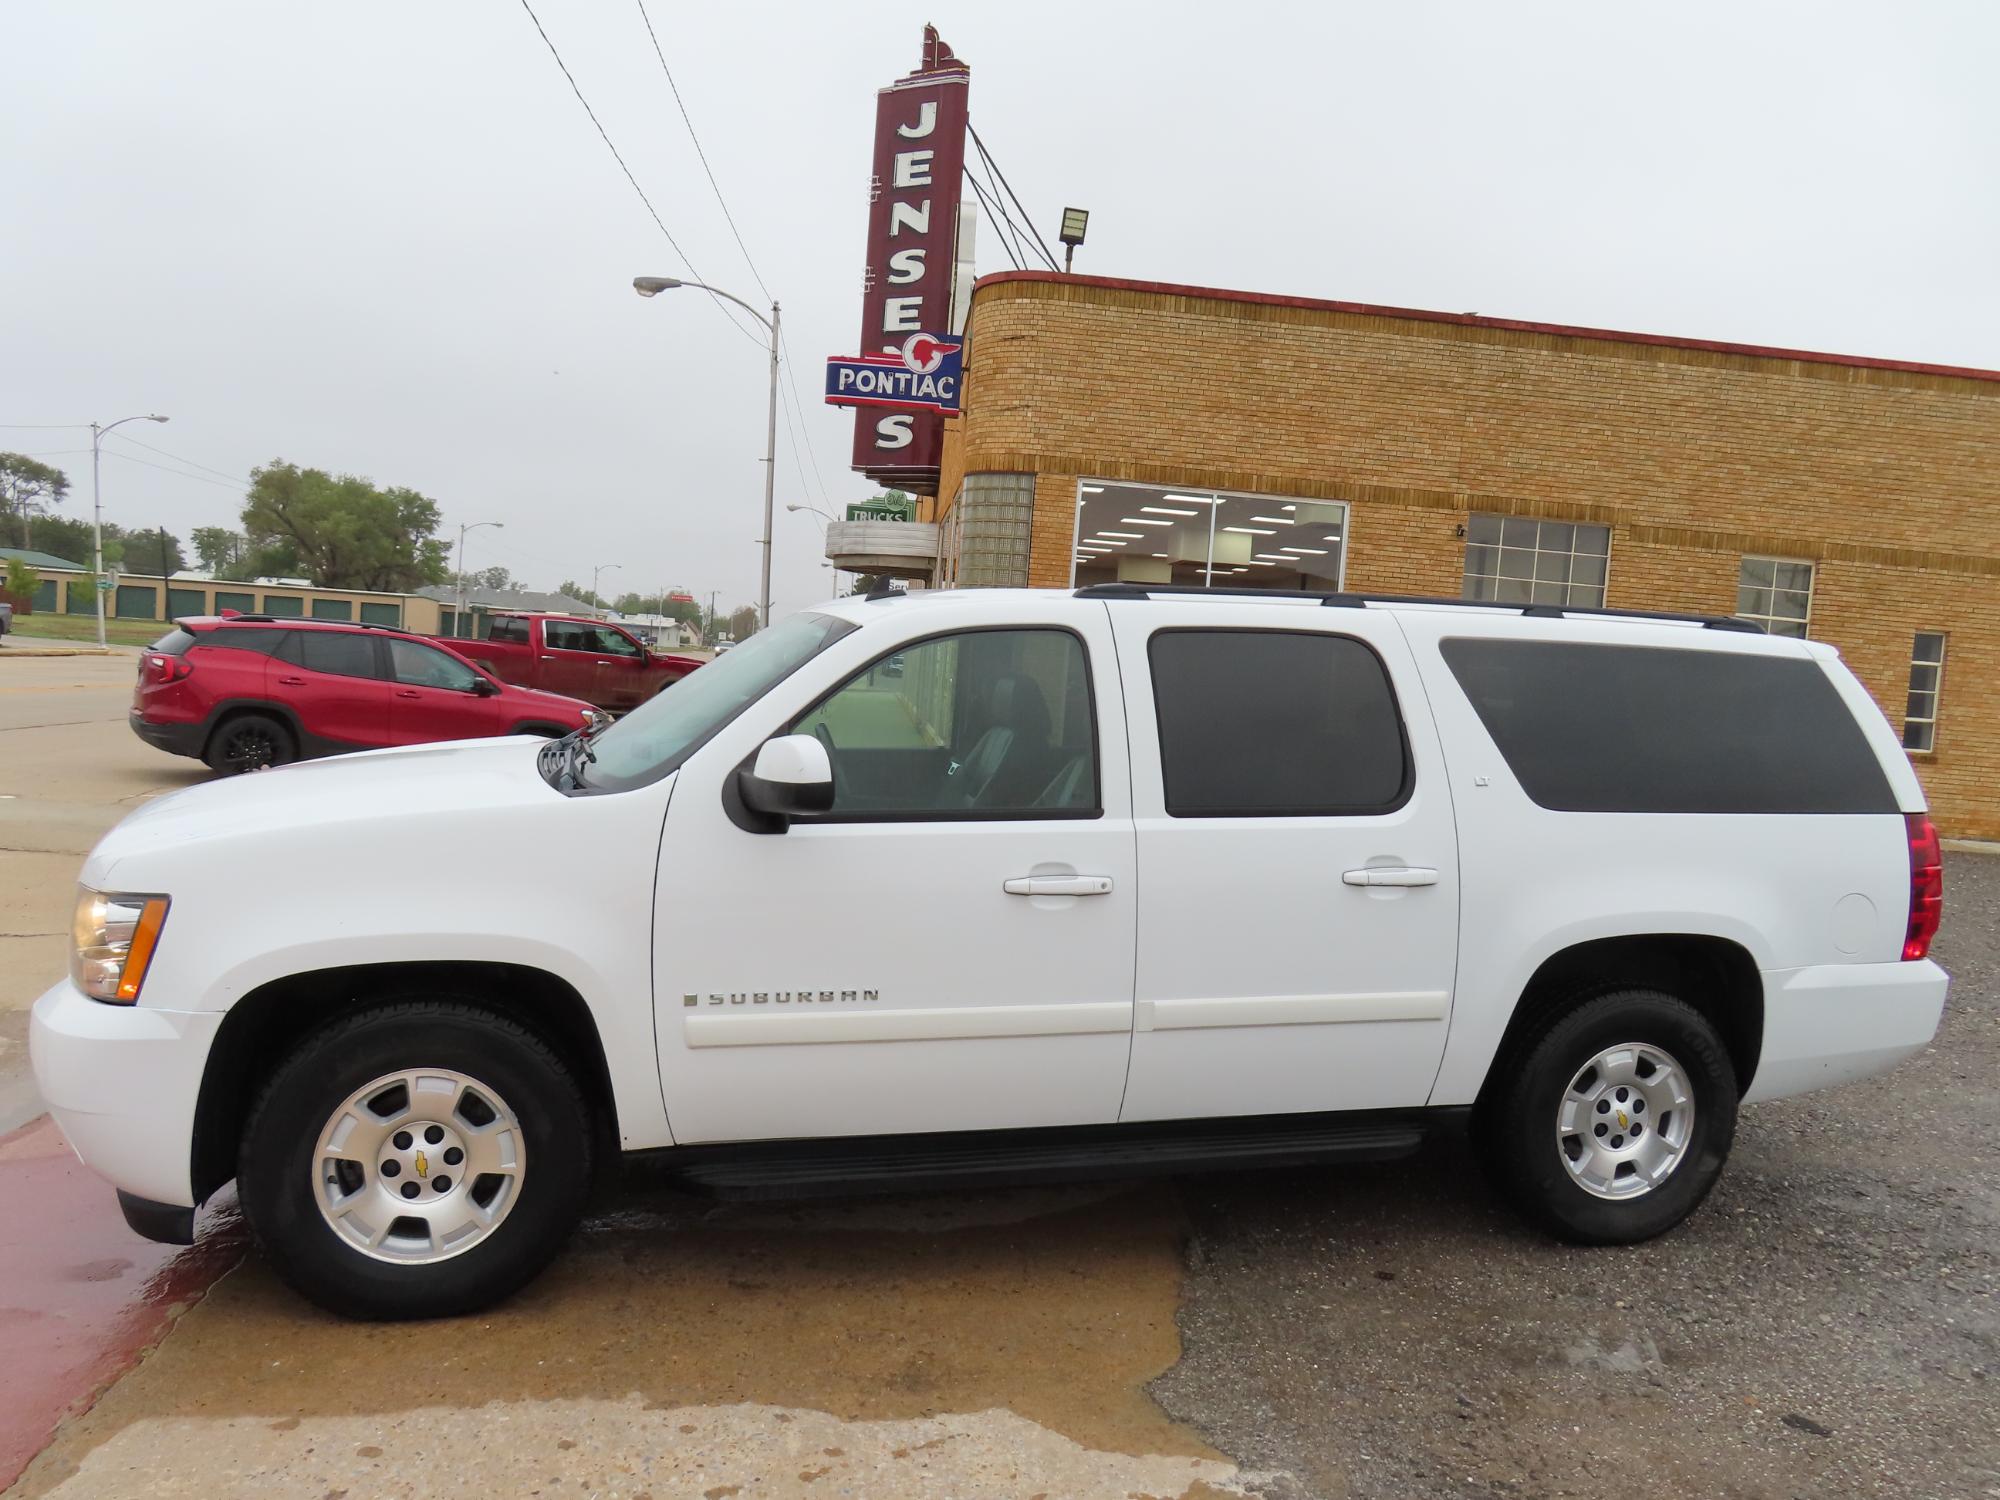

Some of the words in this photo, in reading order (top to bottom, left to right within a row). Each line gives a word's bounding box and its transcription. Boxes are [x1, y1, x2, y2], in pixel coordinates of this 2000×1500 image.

[876, 102, 938, 449] JENSES
[838, 368, 954, 399] PONTIAC
[851, 511, 903, 523] TRUCKS
[1474, 775, 1490, 788] LT
[708, 990, 880, 1006] SUBURBAN
